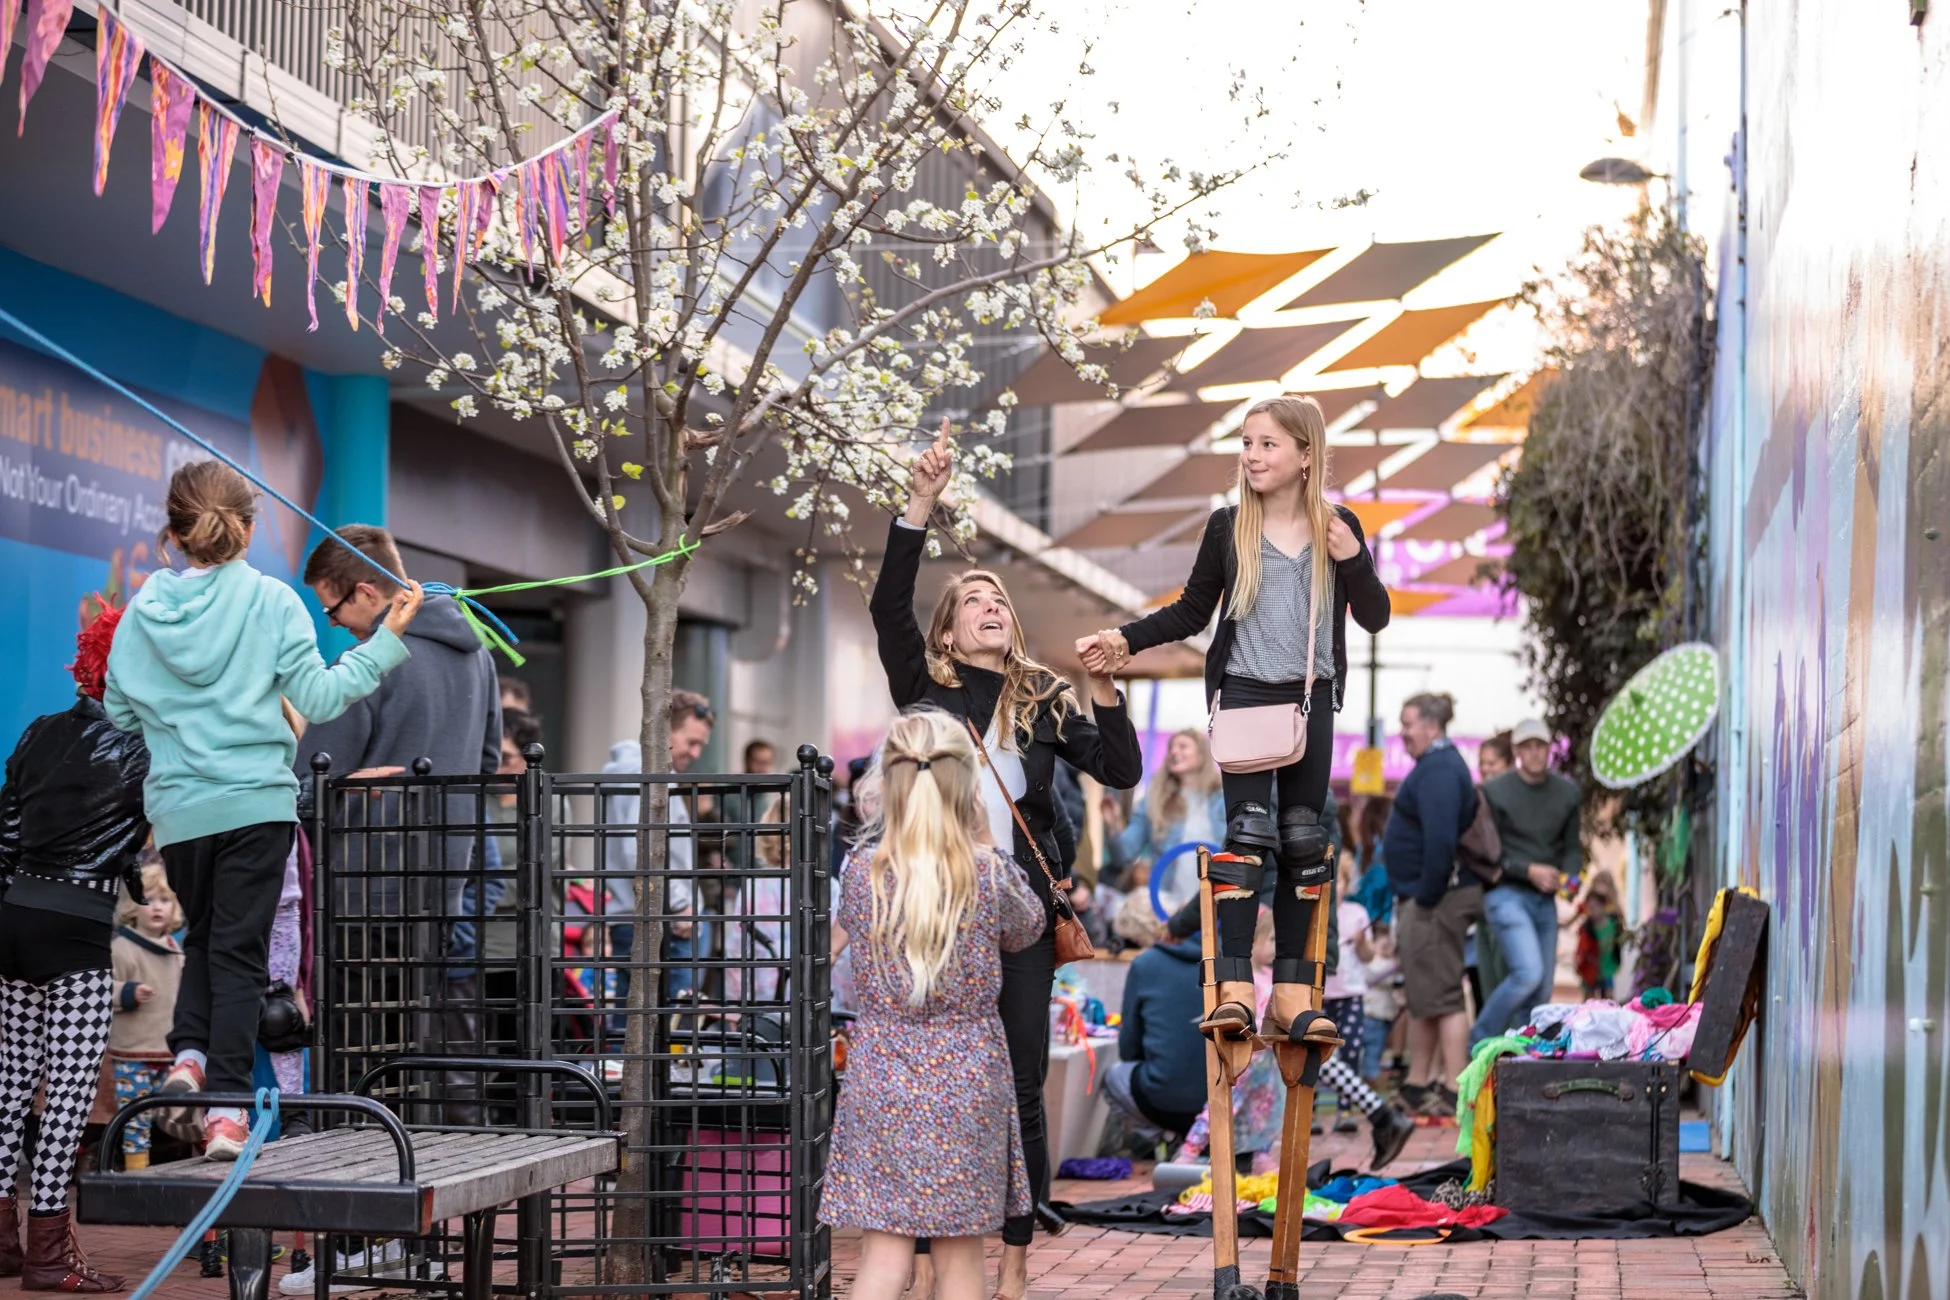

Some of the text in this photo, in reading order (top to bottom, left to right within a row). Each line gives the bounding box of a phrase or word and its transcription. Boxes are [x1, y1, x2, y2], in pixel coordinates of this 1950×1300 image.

[60, 392, 162, 480] business
[0, 455, 25, 499] Not
[26, 462, 63, 509] Your
[66, 474, 132, 535] Ordinary
